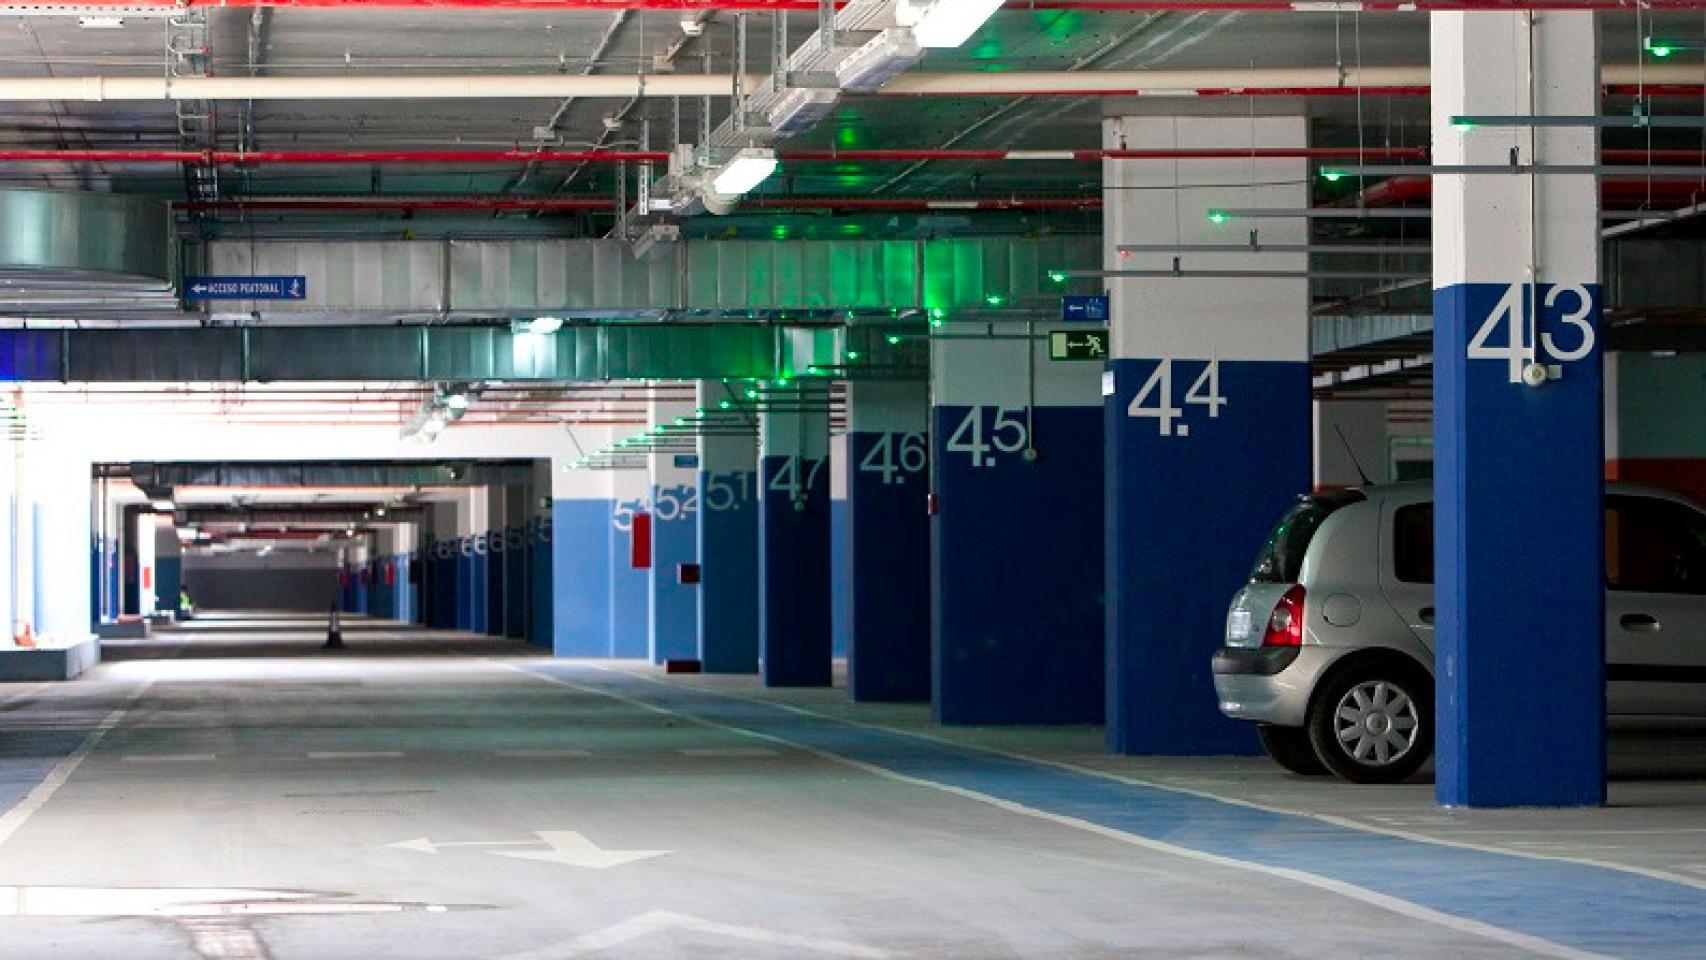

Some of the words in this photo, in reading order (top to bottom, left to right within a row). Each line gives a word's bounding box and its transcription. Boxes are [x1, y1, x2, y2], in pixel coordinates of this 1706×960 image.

[1466, 281, 1595, 383] 4.3
[1127, 357, 1227, 437] 4.4
[859, 431, 925, 484] 4.6
[946, 405, 1026, 467] 4.5
